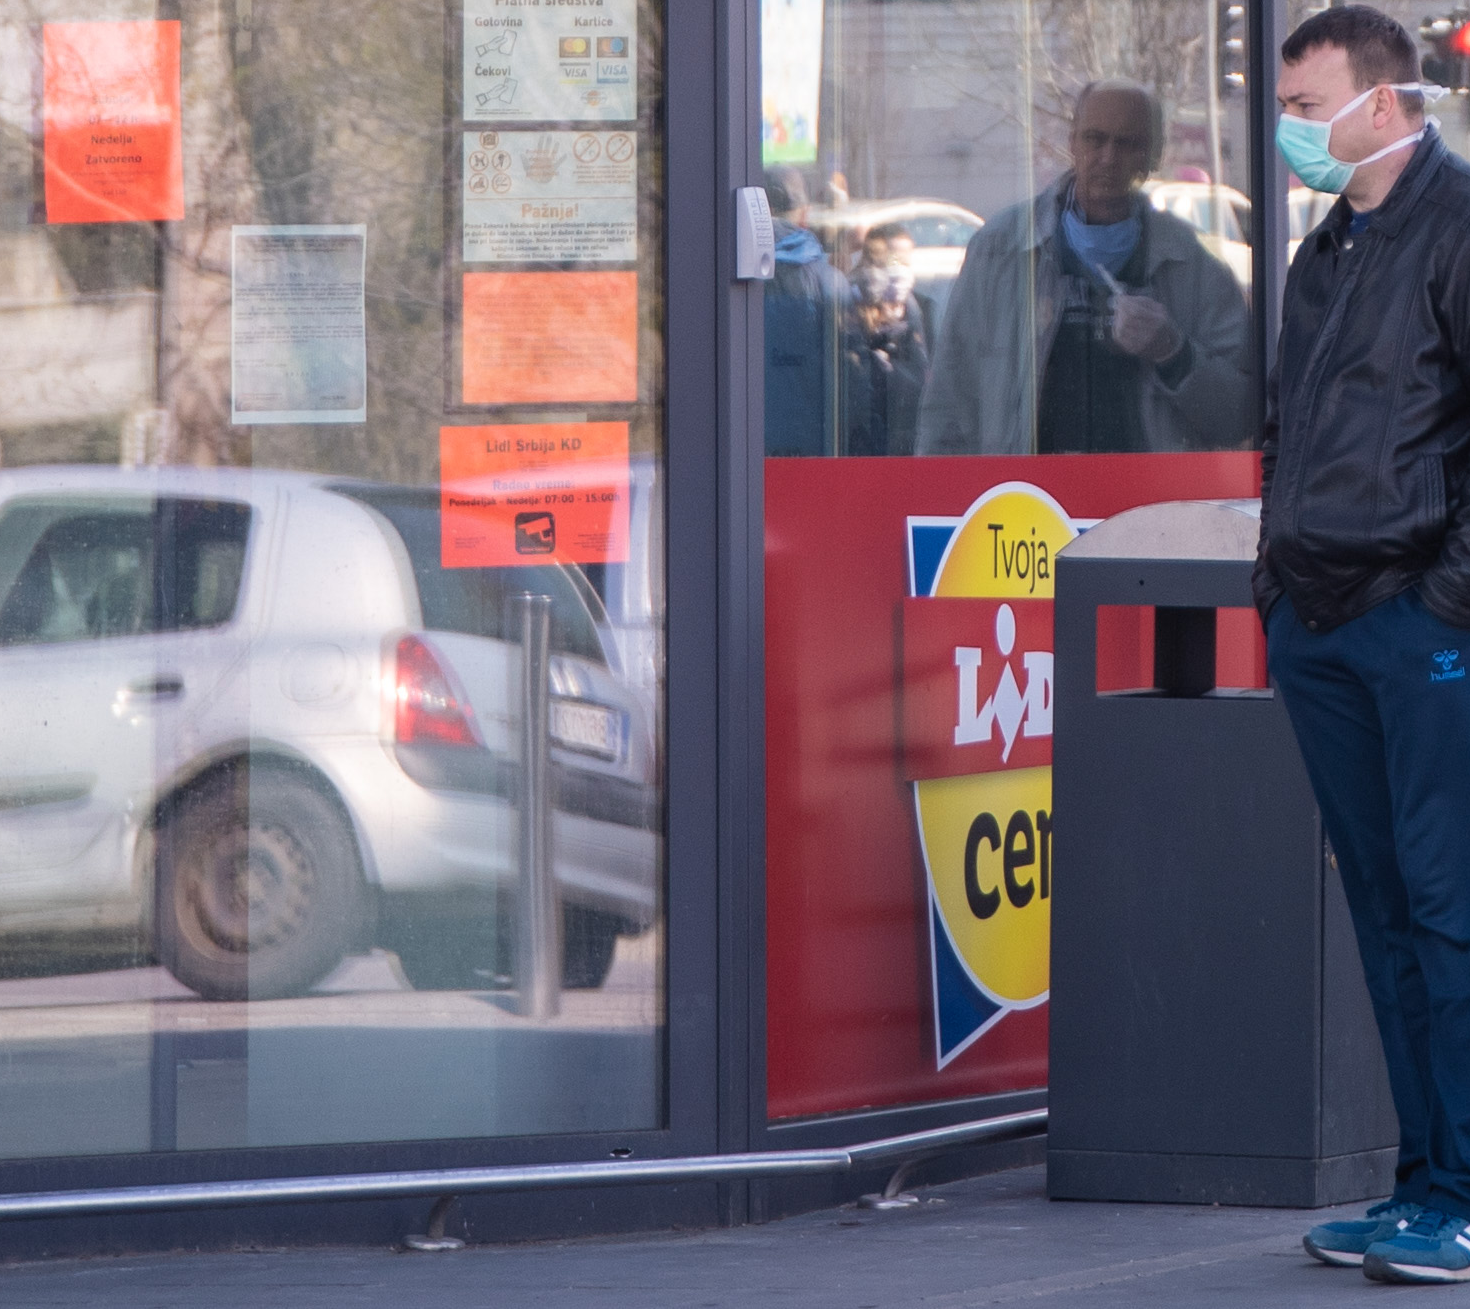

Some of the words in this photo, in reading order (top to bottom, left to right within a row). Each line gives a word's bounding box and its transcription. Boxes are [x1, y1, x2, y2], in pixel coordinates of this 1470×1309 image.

[475, 16, 523, 27] Gotovina
[574, 16, 613, 27] Kartice
[475, 63, 511, 77] Čekovi
[564, 68, 588, 78] VISA
[601, 64, 628, 75] VISA
[85, 153, 142, 165] Zatvoreno
[521, 203, 579, 221] Pažnja!
[486, 440, 511, 453] Lidl
[516, 438, 555, 454] Srbija
[561, 437, 582, 450] KD
[545, 494, 574, 504] 07:00
[987, 524, 1049, 594] Tvoja
